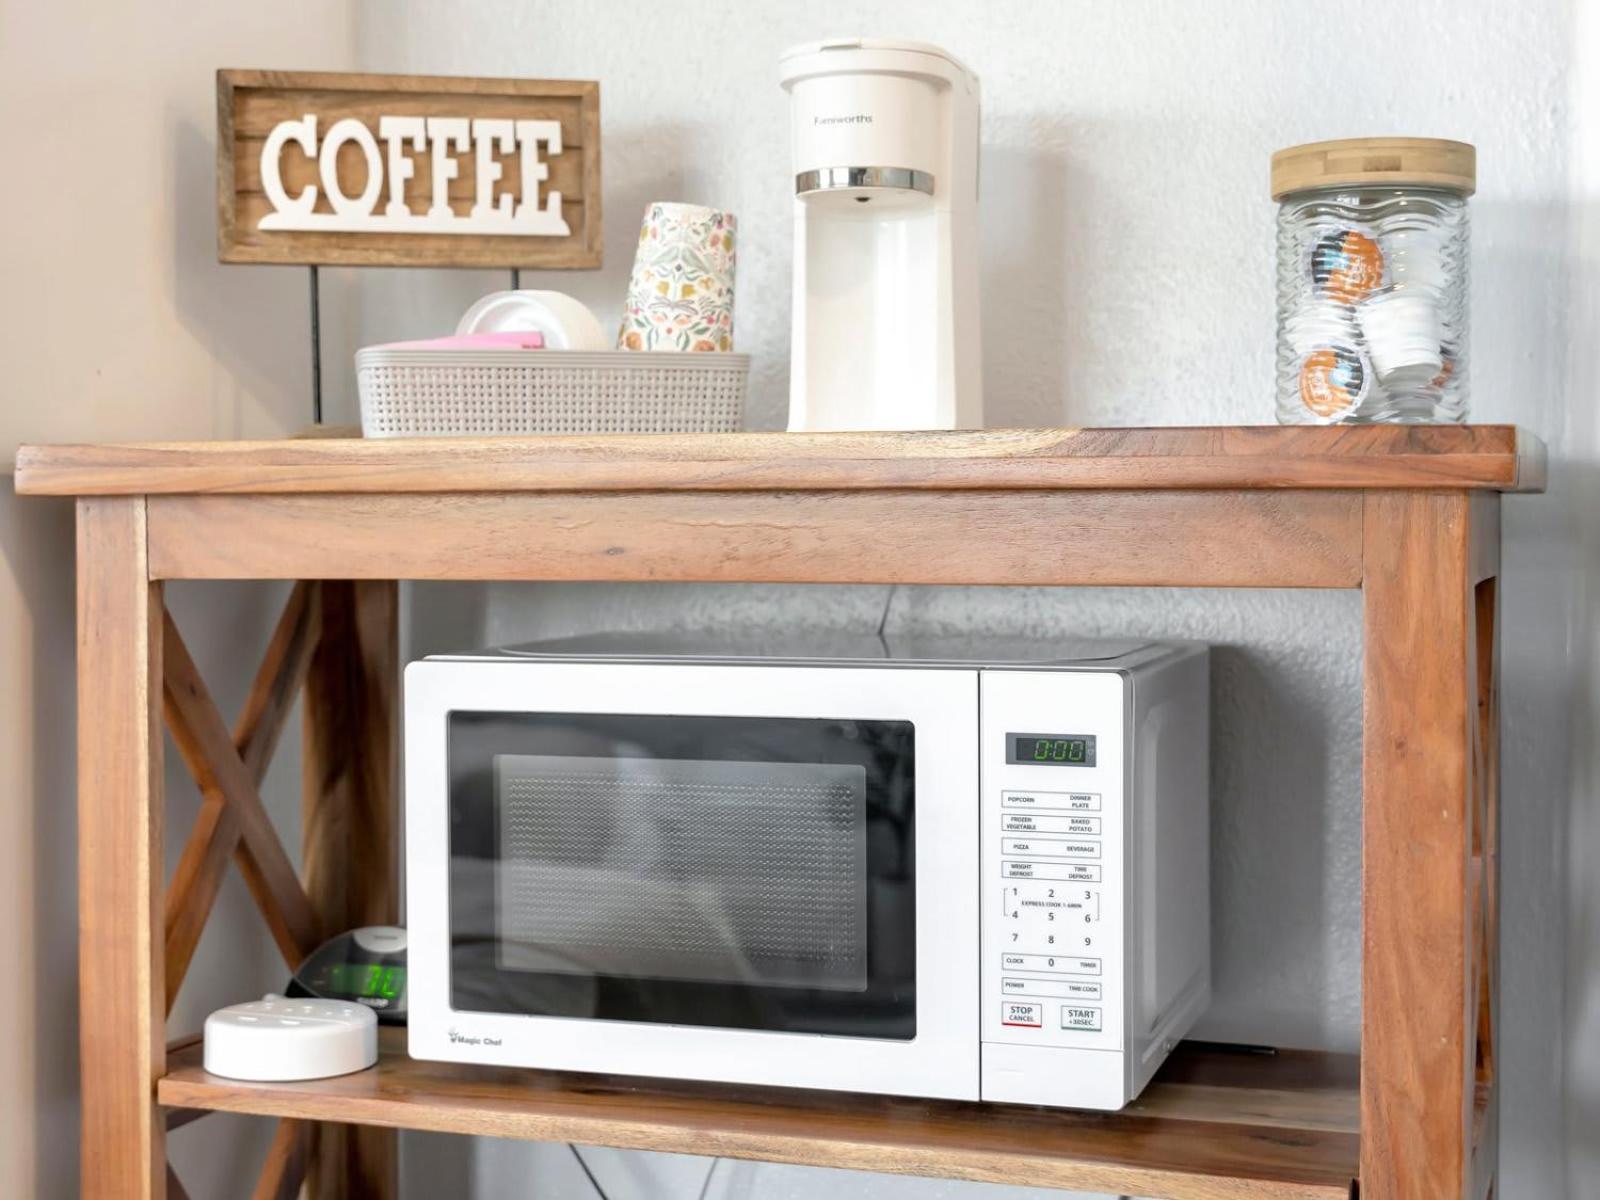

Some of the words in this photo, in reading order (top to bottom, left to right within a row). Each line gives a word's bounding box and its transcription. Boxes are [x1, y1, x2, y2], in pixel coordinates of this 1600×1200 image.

[258, 113, 570, 236] COFFEE
[1034, 740, 1084, 761] 0:00
[1012, 888, 1018, 896] 1
[1048, 889, 1055, 898] 2
[1084, 891, 1092, 900] 3
[1012, 911, 1018, 919] 4
[1048, 912, 1054, 921] 5
[1084, 914, 1091, 923] 6
[1012, 933, 1018, 942] 7
[1048, 935, 1054, 944] 8
[1084, 937, 1091, 946] 9
[1048, 958, 1055, 967] 0
[1010, 1006, 1033, 1015] STOP
[1068, 1009, 1095, 1019] START
[1009, 1014, 1034, 1023] CANCEL
[458, 1035, 480, 1046] Magic
[483, 1037, 502, 1046] Chef
